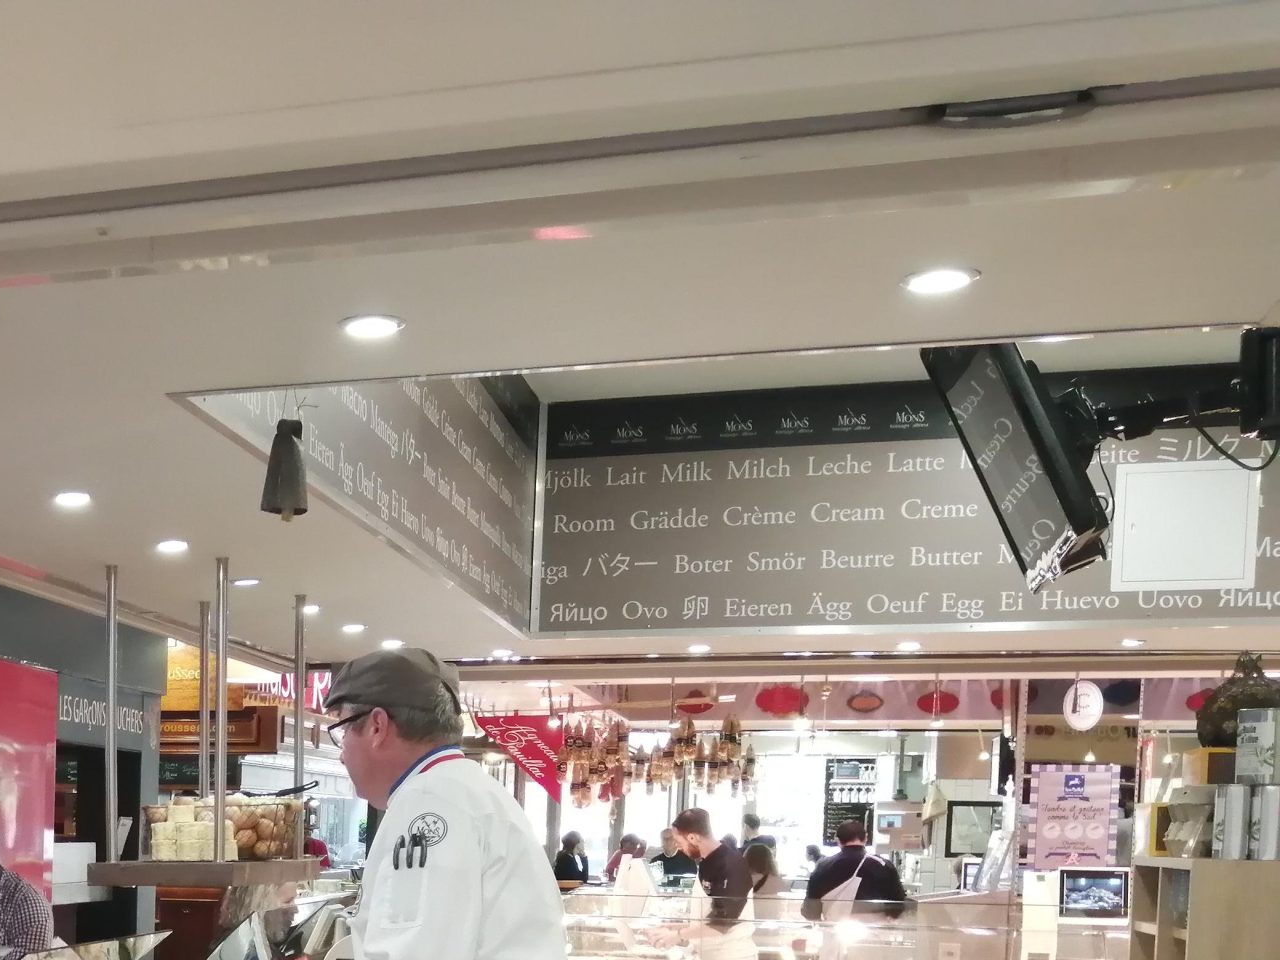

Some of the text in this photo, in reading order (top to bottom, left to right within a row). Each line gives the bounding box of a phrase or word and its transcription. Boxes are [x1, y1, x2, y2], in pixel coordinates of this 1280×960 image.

[309, 421, 334, 471] Eieren
[338, 441, 353, 495] Ägg
[356, 462, 376, 501] Oeuf
[376, 477, 389, 521] Egg
[606, 466, 646, 486] Lait
[661, 459, 712, 483] Milk
[727, 455, 791, 480] Milch
[806, 454, 872, 477] Leche
[887, 452, 945, 473] Latte
[553, 499, 978, 534] Room Grädde Crème Cream Creme
[582, 553, 658, 578] バター
[674, 554, 733, 575] Boter
[746, 551, 806, 572] Smör
[820, 548, 895, 570] Beurre
[910, 545, 983, 567] Butter
[550, 600, 608, 625] Яйцо
[622, 600, 668, 620] Ovo
[683, 595, 709, 621] 卵
[723, 589, 1202, 621] Eieren Ägg Oeuf Egg Ei Huevo Uovo
[59, 695, 72, 721] LES
[117, 706, 143, 734] UCHERS
[500, 718, 558, 762] Agneau
